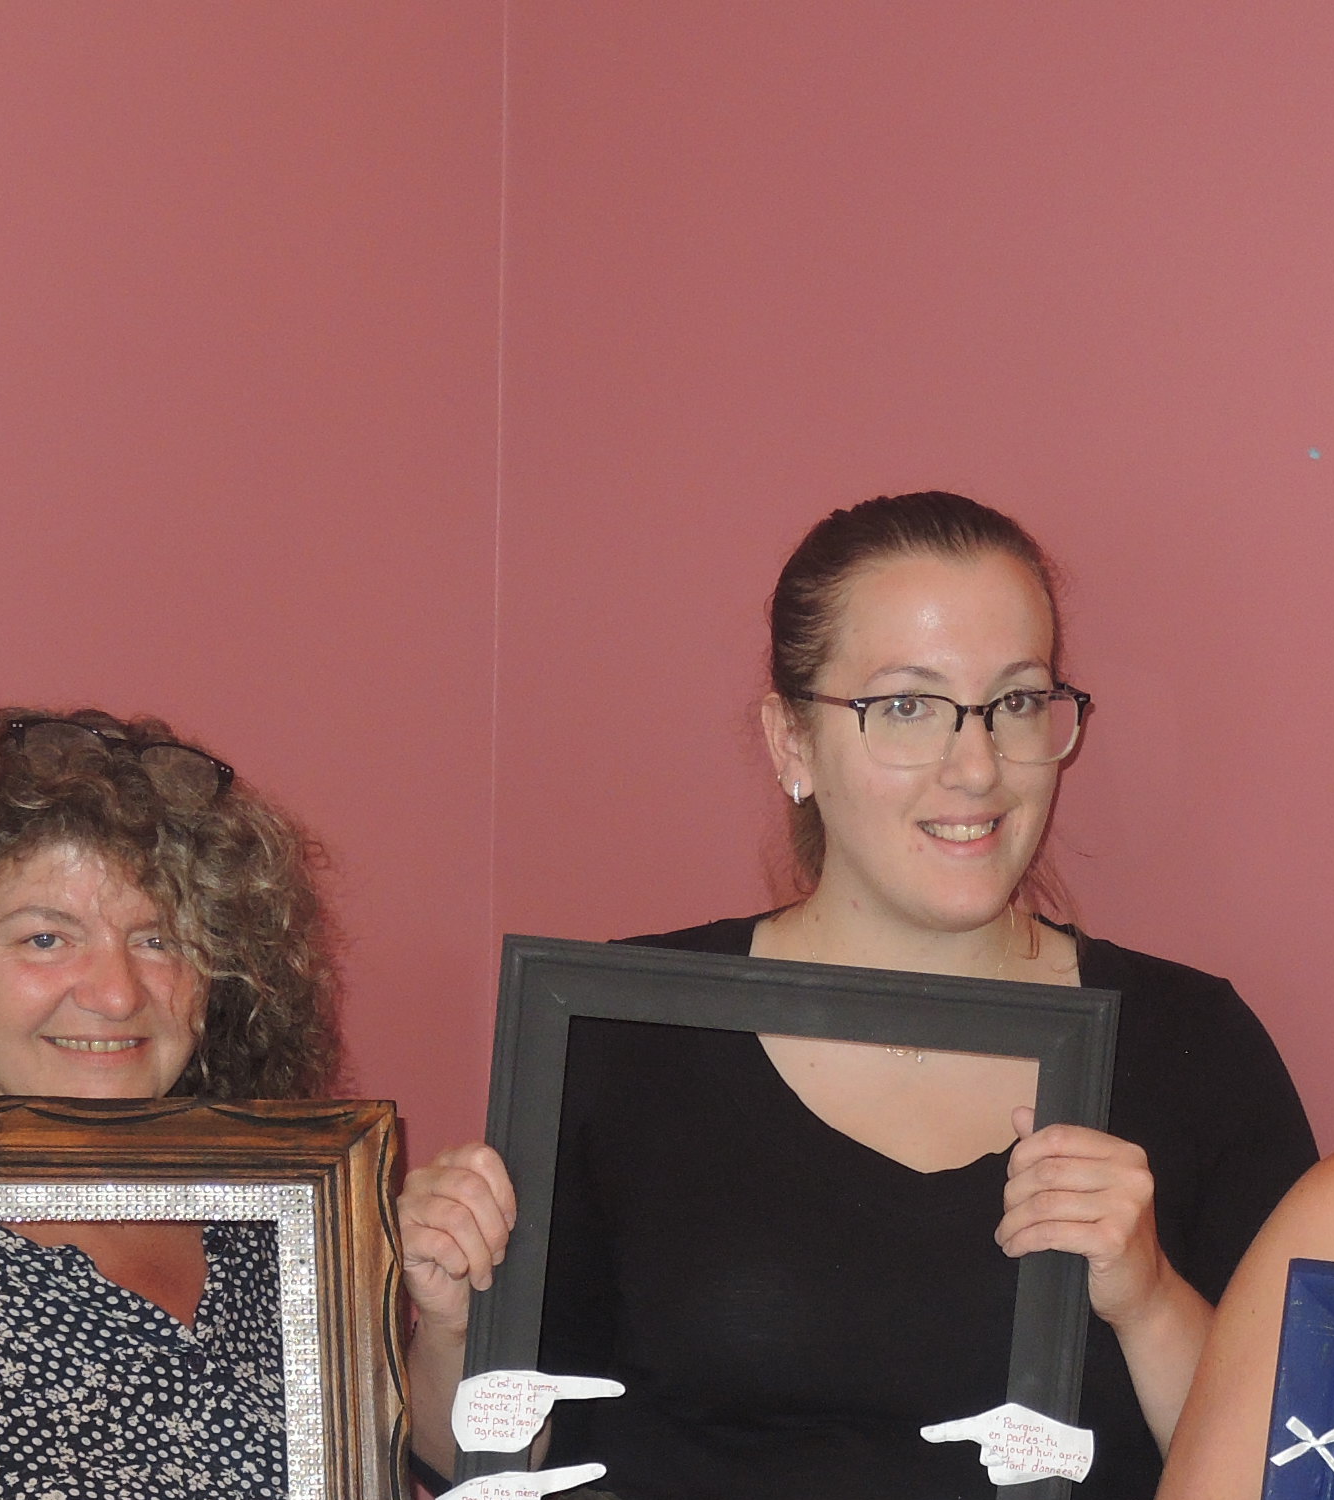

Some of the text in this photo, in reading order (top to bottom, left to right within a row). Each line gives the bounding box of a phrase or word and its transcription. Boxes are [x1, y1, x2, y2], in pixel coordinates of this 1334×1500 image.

[474, 1389, 539, 1403] charmant et
[526, 1405, 540, 1416] ne
[467, 1413, 489, 1429] peut
[492, 1416, 510, 1431] pas
[988, 1431, 1058, 1449] en parles-tu
[1003, 1456, 1027, 1470] tant
[1058, 1448, 1089, 1466] après
